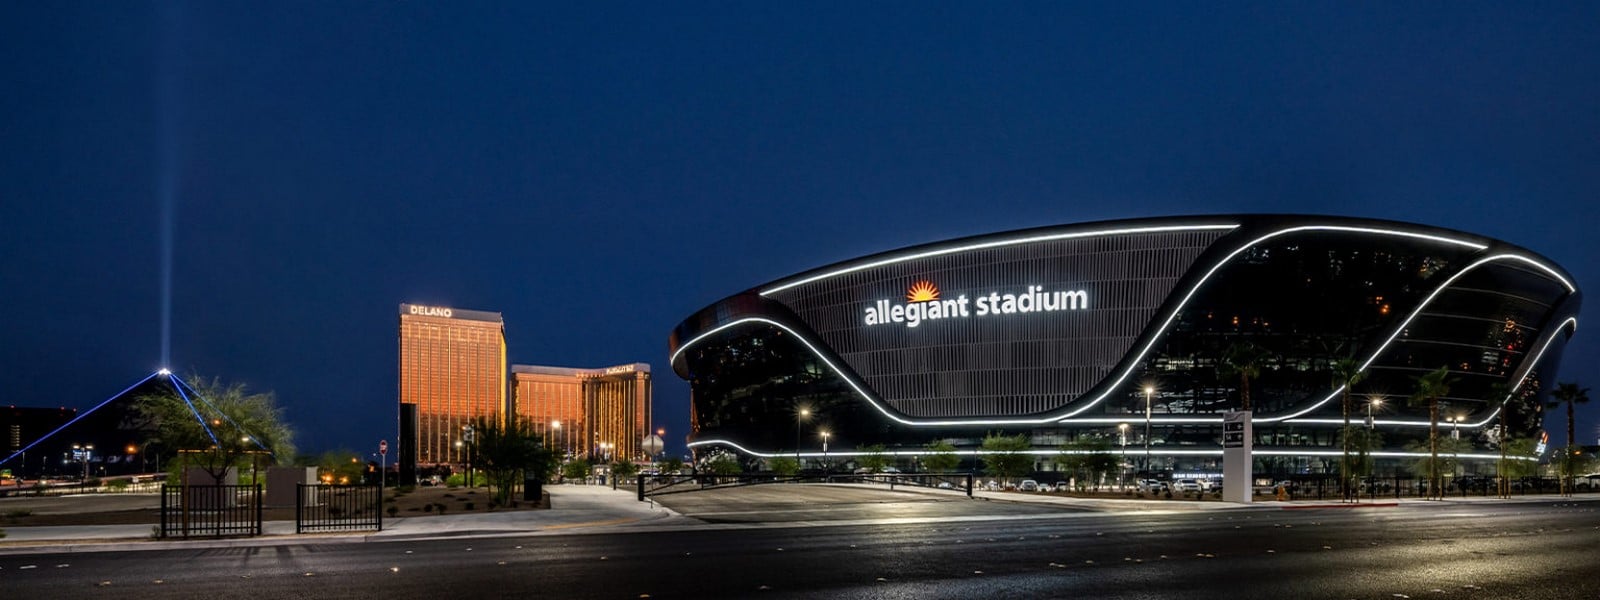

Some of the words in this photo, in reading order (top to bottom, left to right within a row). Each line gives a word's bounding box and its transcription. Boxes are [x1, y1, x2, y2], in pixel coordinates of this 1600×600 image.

[410, 305, 452, 318] DELANO
[864, 294, 969, 327] allegiant
[976, 285, 1088, 316] stadium
